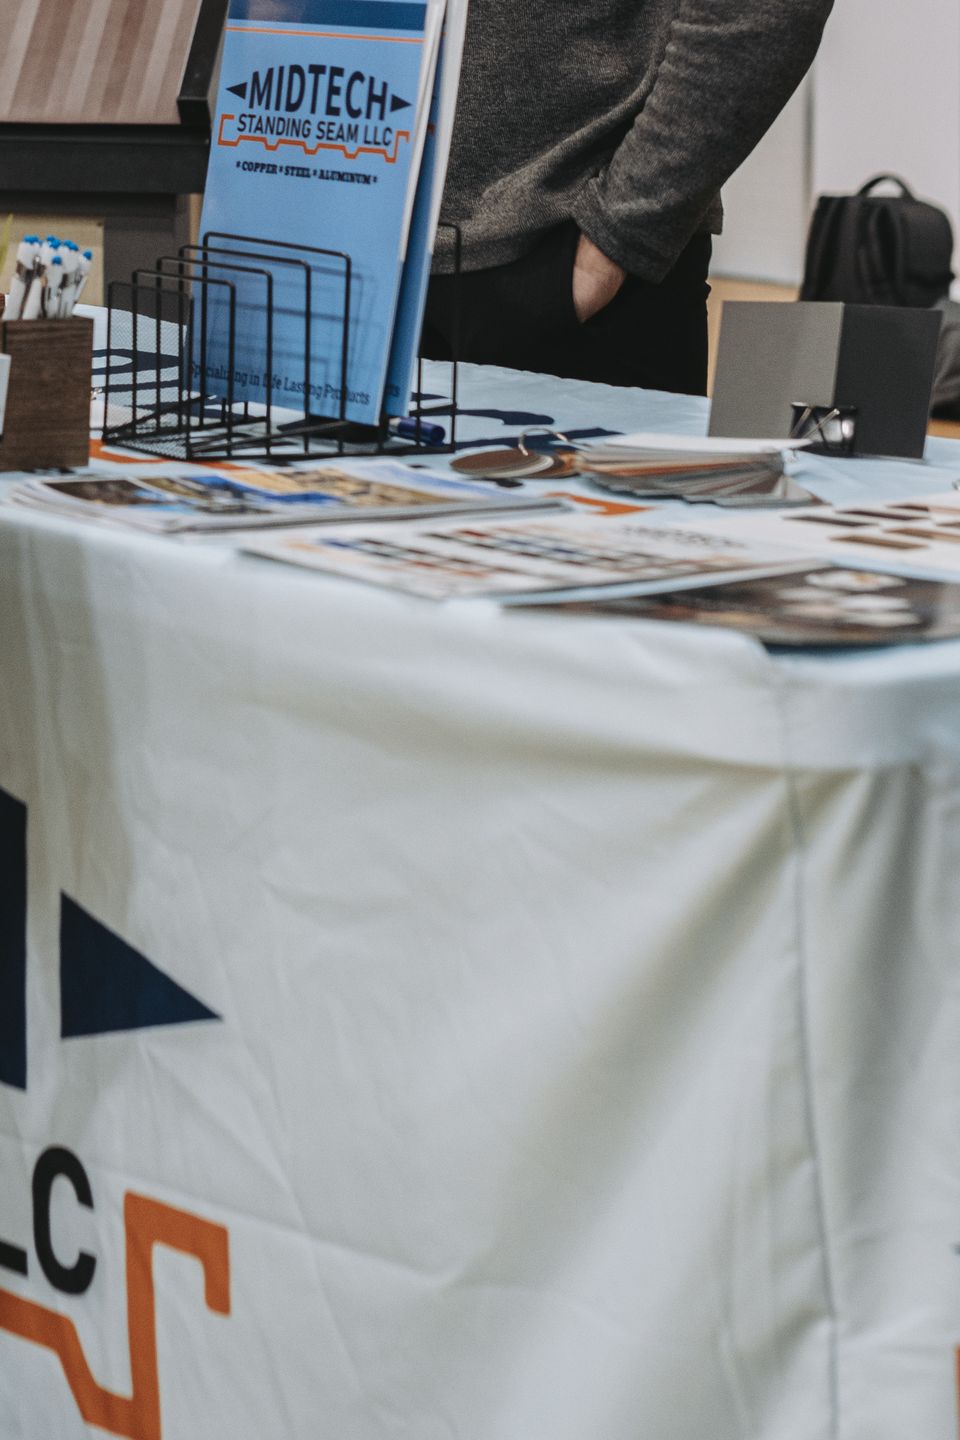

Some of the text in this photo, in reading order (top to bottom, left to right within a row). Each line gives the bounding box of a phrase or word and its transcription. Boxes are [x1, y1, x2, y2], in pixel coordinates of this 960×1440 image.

[248, 63, 389, 122] MIDTECH
[237, 113, 393, 146] STANDING SEAM LLC
[242, 160, 372, 185] COPPER STEEL ALUMINUM
[249, 370, 260, 387] in
[284, 377, 323, 400] Lastng
[324, 383, 370, 405] Proucts
